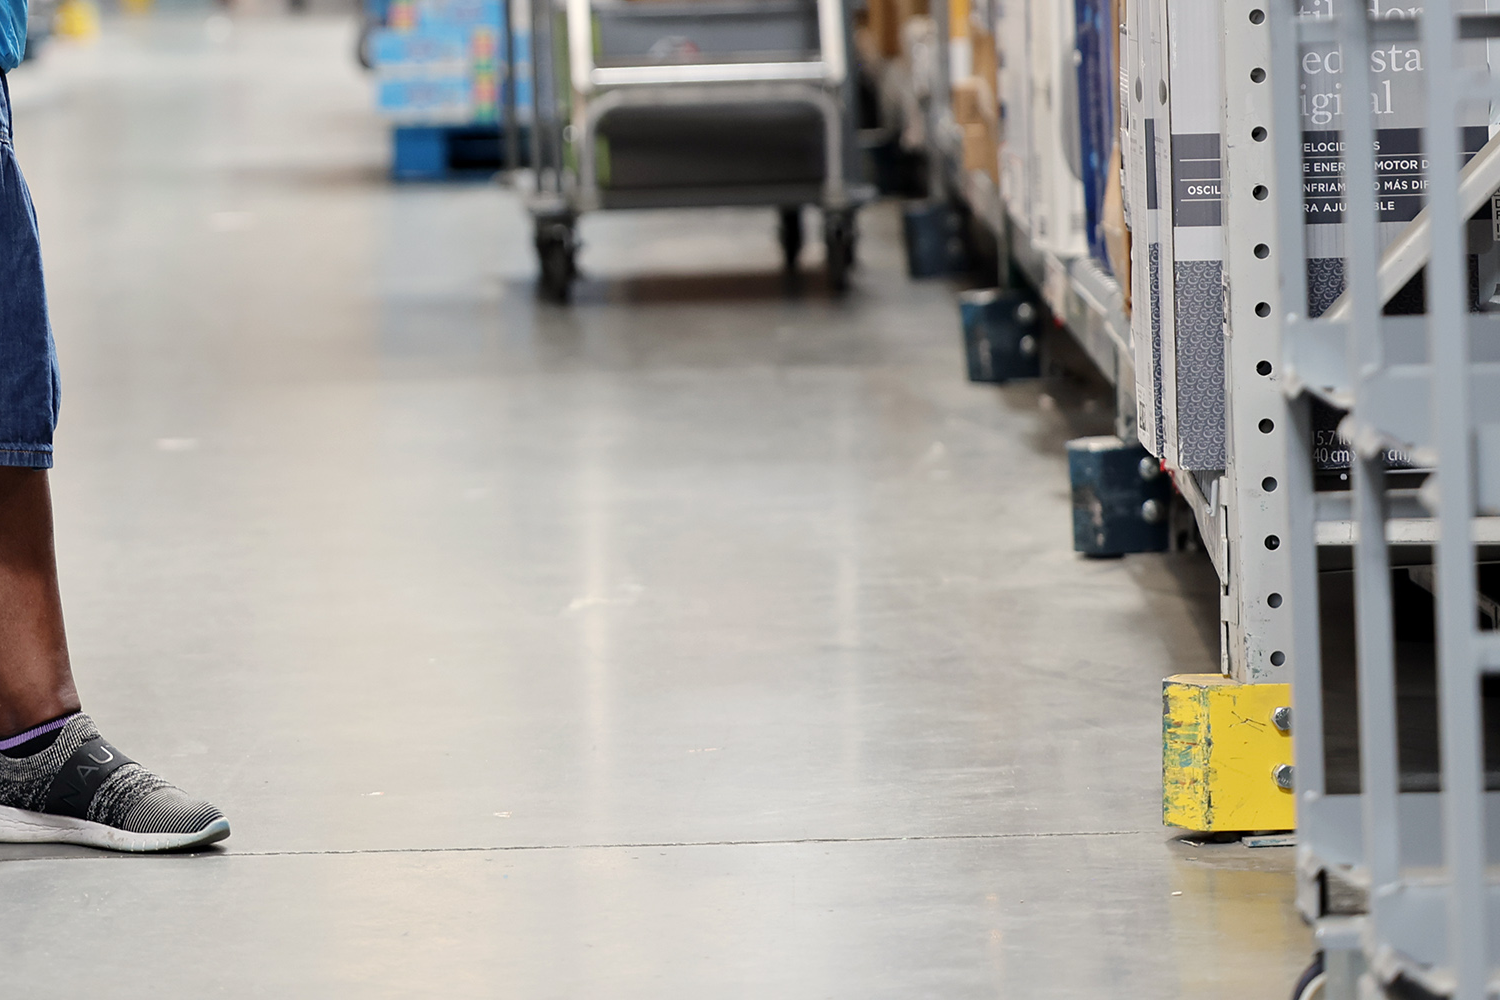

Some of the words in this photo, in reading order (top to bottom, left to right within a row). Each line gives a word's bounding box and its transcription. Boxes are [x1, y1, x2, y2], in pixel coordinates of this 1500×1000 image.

[1374, 160, 1418, 171] MOTOR
[1188, 185, 1221, 195] OSCIL
[1384, 179, 1408, 191] MÁS
[1411, 180, 1430, 190] DIF
